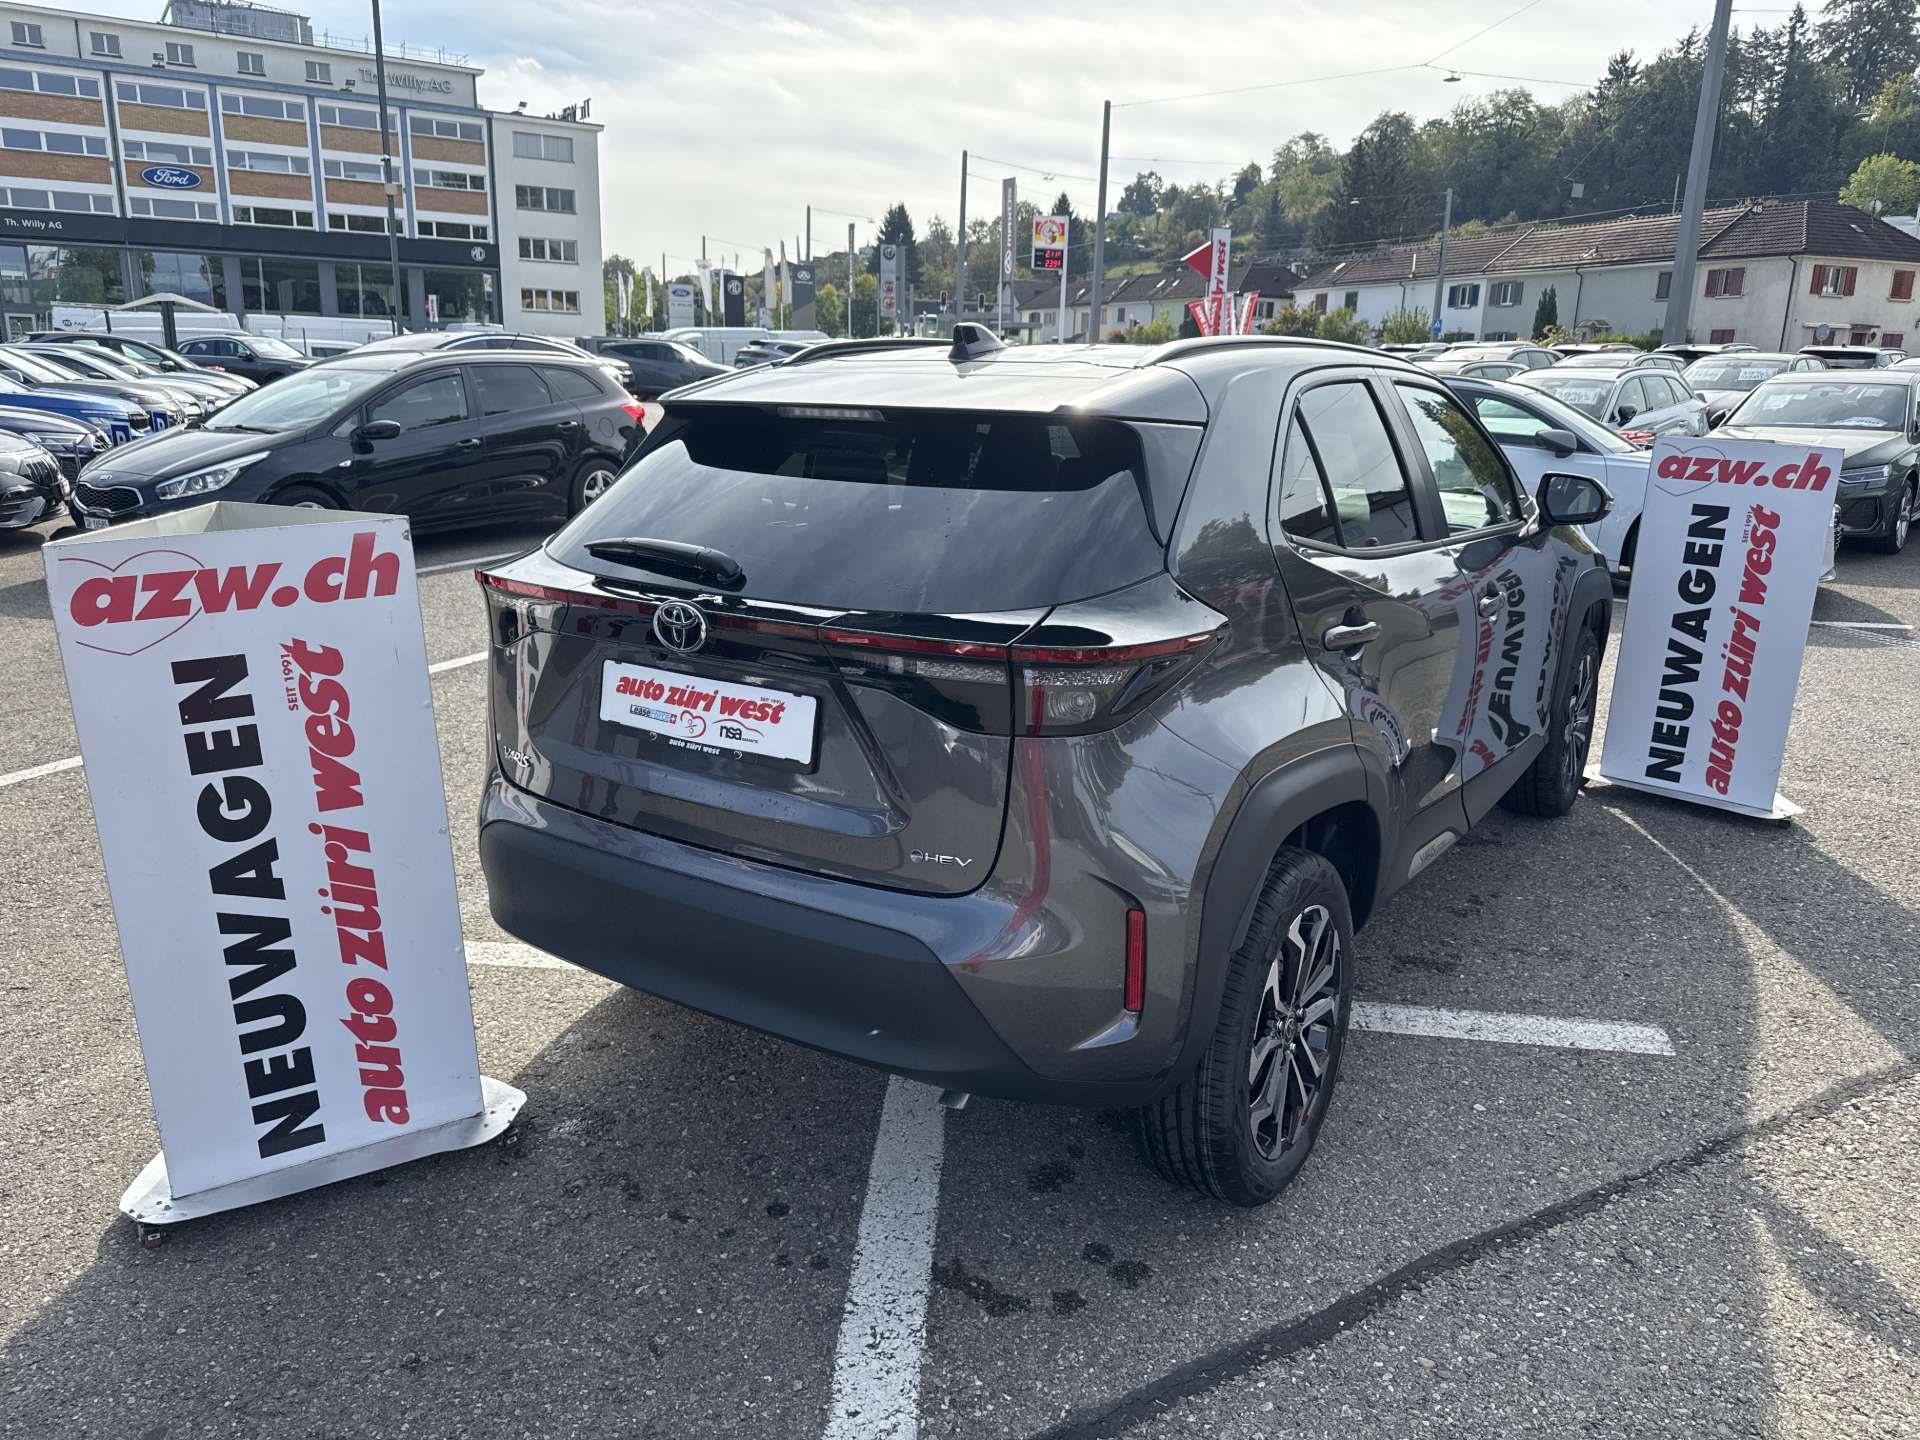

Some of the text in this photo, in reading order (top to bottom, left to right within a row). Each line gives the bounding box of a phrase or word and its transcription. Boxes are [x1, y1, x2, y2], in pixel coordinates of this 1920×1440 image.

[389, 70, 426, 93] Willy
[430, 78, 453, 94] AG
[153, 167, 190, 187] Ford
[4, 217, 63, 230] Th. Willy AG
[1655, 453, 1832, 492] azw.ch
[1741, 529, 1750, 544] SEIT
[69, 531, 401, 628] azw.ch
[1644, 503, 1731, 784] NEUWAGEN
[1704, 503, 1781, 796] auto züri west
[282, 652, 298, 712] SEIT 1991
[615, 676, 788, 725] auto züri west
[668, 738, 721, 756] auto züri west
[719, 724, 742, 741] nsa
[924, 851, 973, 868] HEV
[280, 636, 409, 1125] auto züri west
[170, 653, 327, 1160] NEUWAGEN
